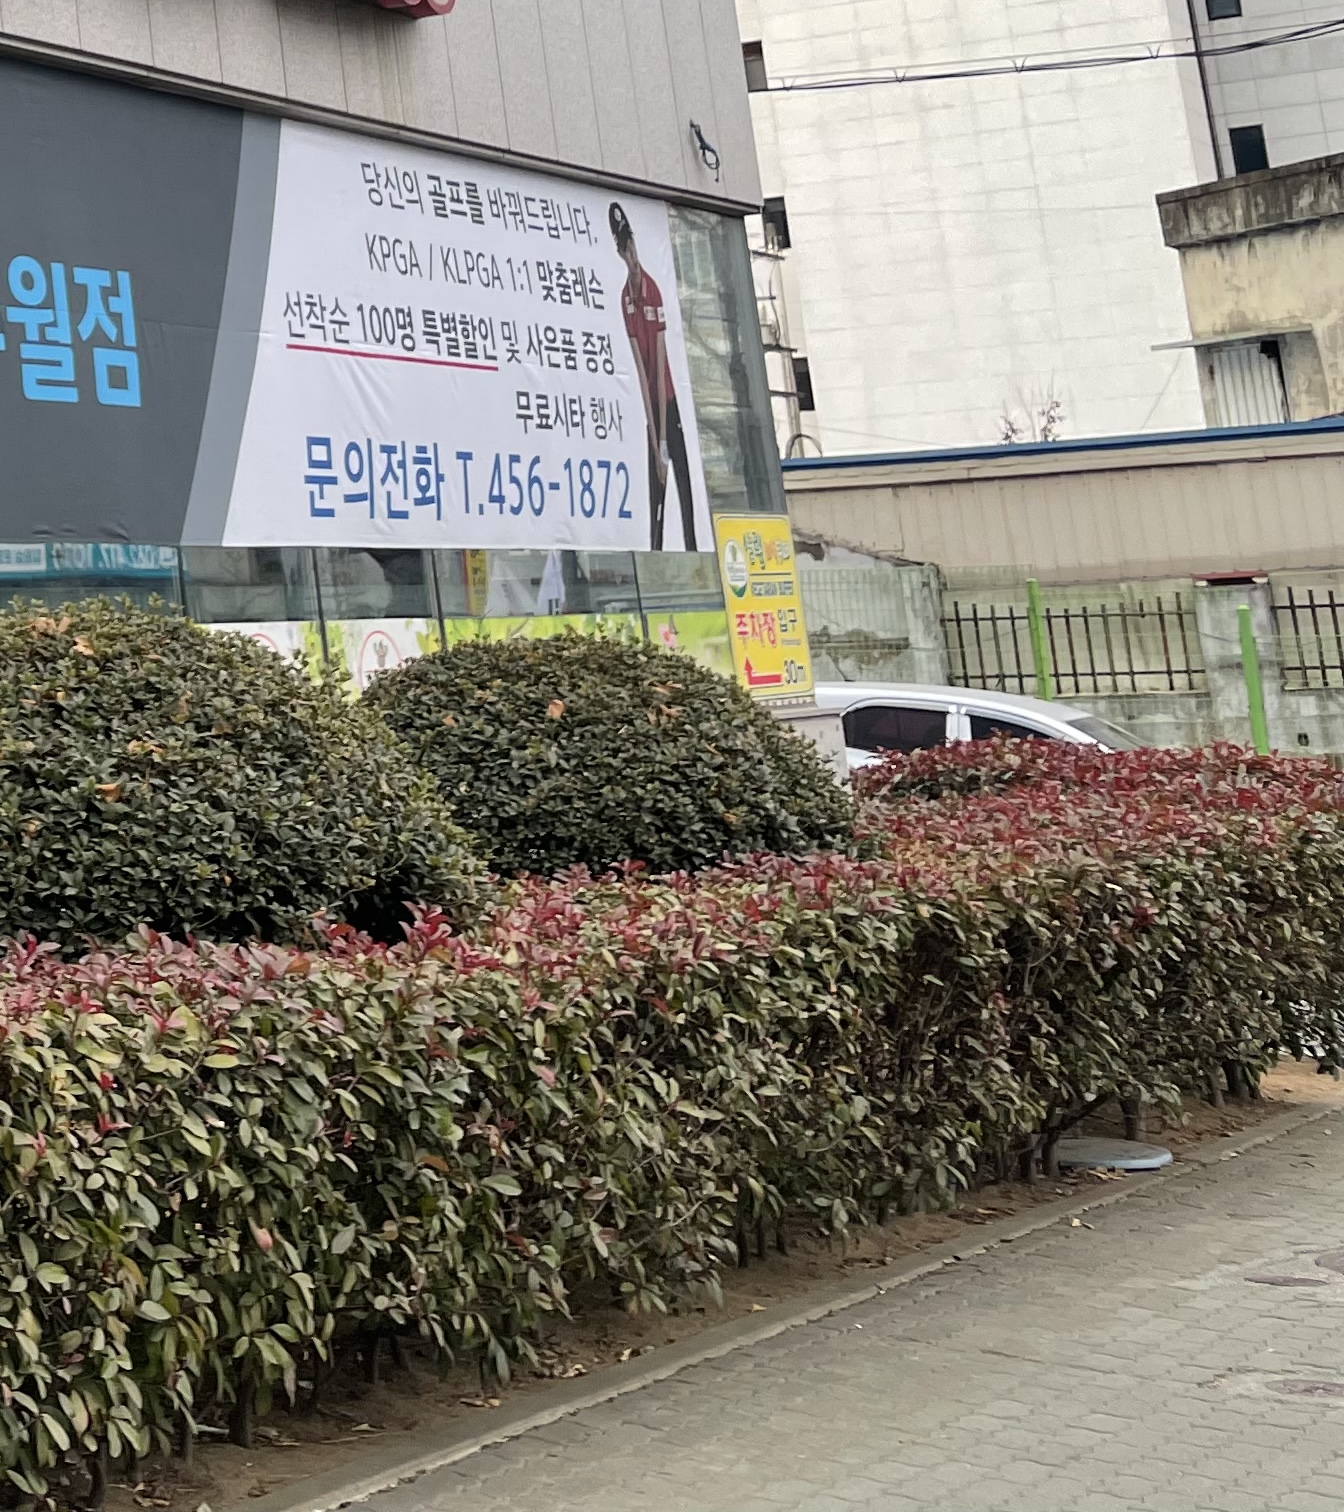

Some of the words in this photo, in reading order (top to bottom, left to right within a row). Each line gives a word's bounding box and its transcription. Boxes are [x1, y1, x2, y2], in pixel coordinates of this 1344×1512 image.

[360, 162, 424, 214] 당신의
[426, 173, 485, 225] 골프를
[487, 186, 599, 246] 바꿔드립니다.
[365, 233, 423, 278] KPGA
[440, 245, 504, 290] KLPGA
[506, 256, 533, 294] 1:1
[536, 260, 605, 311] 맞춤레슨
[283, 291, 350, 344] 선착순
[357, 303, 416, 352] 100명
[422, 308, 498, 361] 특별할인
[500, 319, 522, 364] 및
[526, 322, 579, 371] 사은품
[582, 330, 615, 376] 증정
[515, 390, 586, 439] 무료시타
[590, 397, 624, 442] 행사
[303, 435, 445, 521] 문의전화
[455, 451, 633, 519] T.456-1872
[735, 612, 778, 648] 주차장
[777, 609, 798, 633] 입구
[784, 660, 806, 684] 30m
